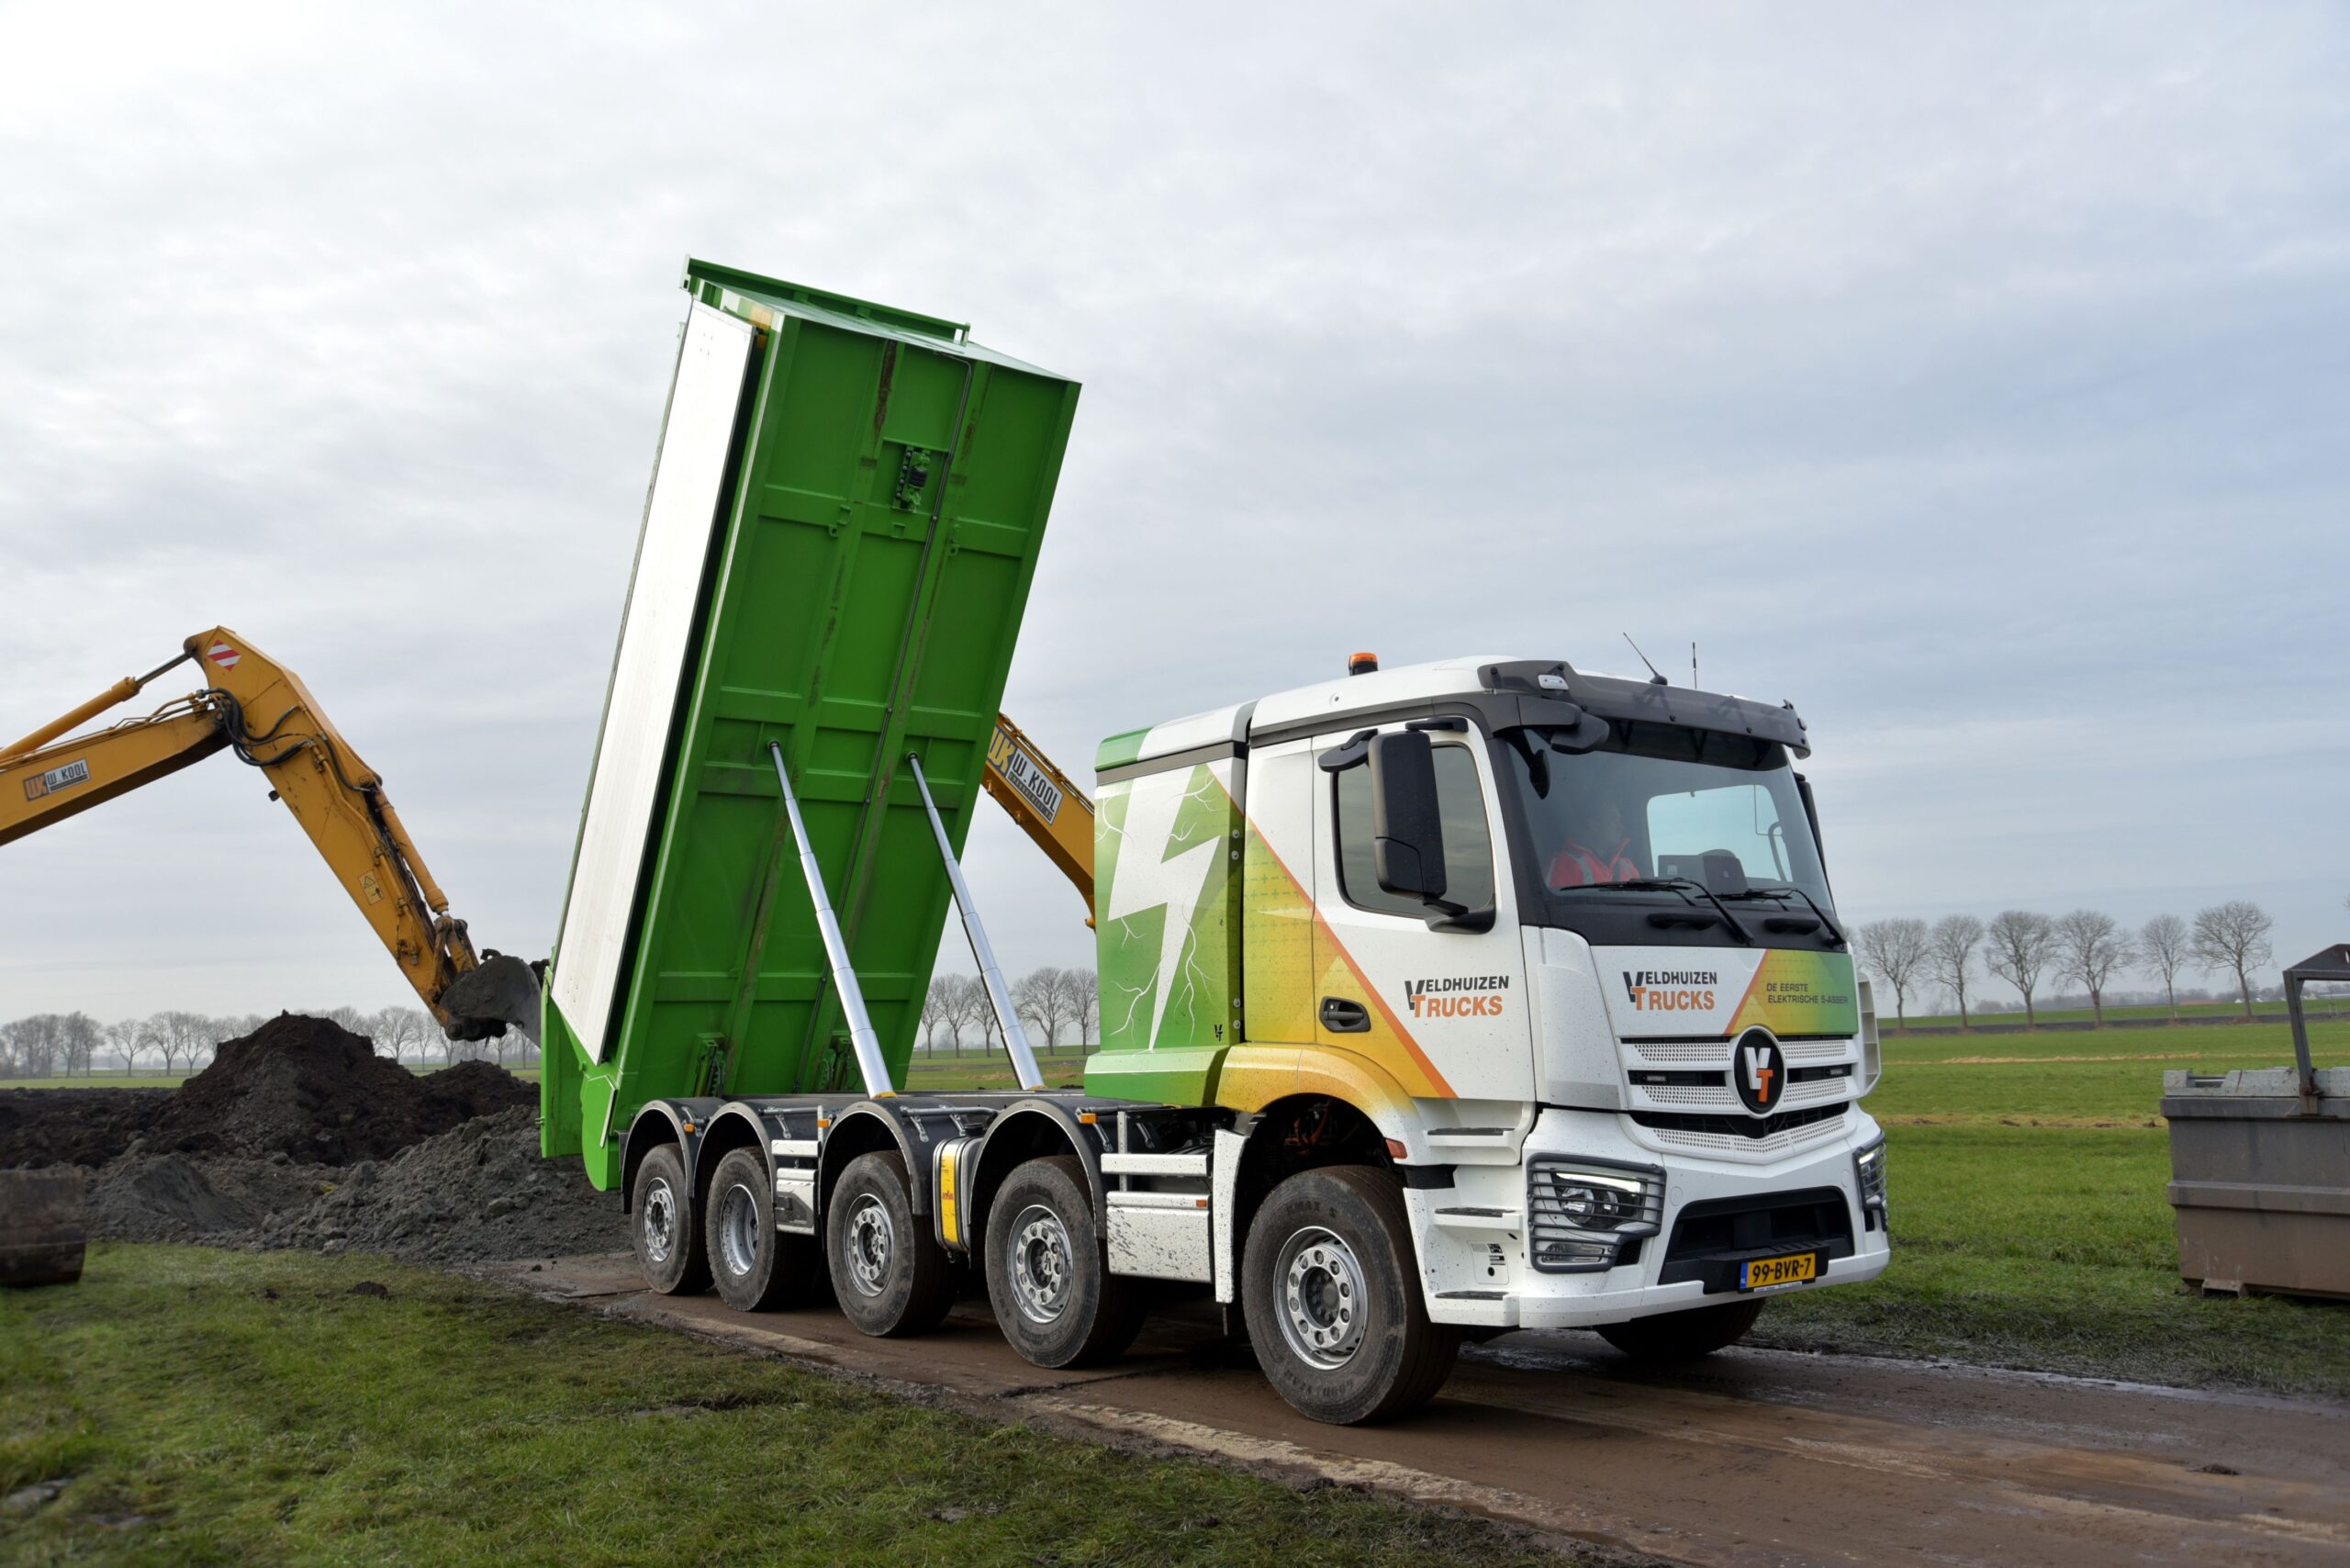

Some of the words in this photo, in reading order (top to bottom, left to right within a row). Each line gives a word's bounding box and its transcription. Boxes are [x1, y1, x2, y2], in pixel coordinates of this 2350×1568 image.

[1404, 976, 1509, 1011] VELDHUIZEN
[1622, 971, 1718, 1002] VELDHUIZEN
[1766, 983, 1777, 992] DE
[1780, 983, 1808, 992] EERSTE
[1410, 995, 1503, 1018] TRUCKS
[1630, 987, 1715, 1011] TRUCKS
[1768, 994, 1818, 1003] ELEKTRISCHE
[1820, 995, 1848, 1004] 5-ASSER
[1752, 1258, 1812, 1284] 99-BVR-7
